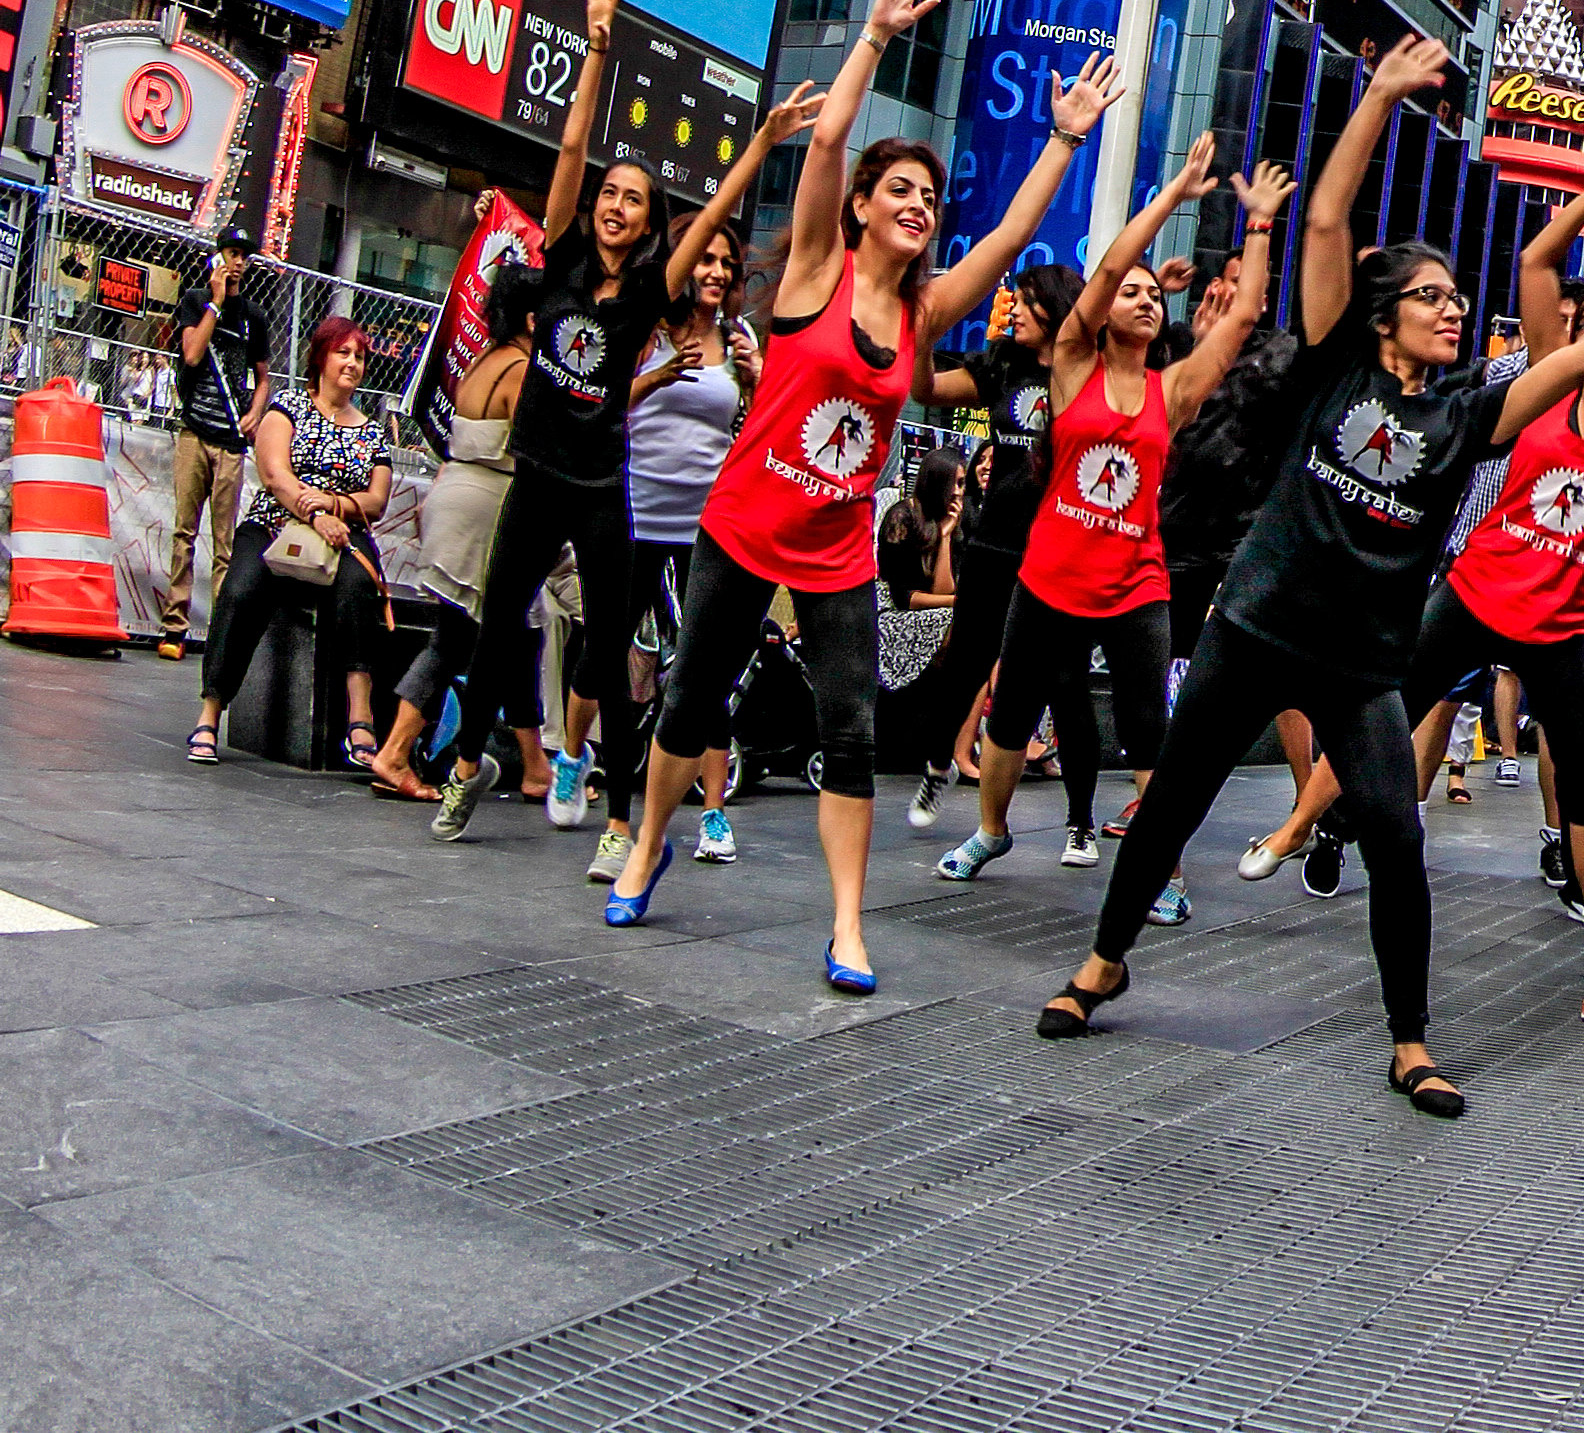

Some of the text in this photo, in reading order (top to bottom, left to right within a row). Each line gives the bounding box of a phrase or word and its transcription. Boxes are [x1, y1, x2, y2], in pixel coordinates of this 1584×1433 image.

[525, 12, 589, 57] NEW YORK
[1024, 19, 1087, 45] Morgan
[650, 39, 678, 60] mobile
[707, 66, 737, 87] weather
[95, 172, 193, 212] radioshack
[105, 260, 142, 286] PRIVATE
[100, 279, 144, 306] PROPERTY
